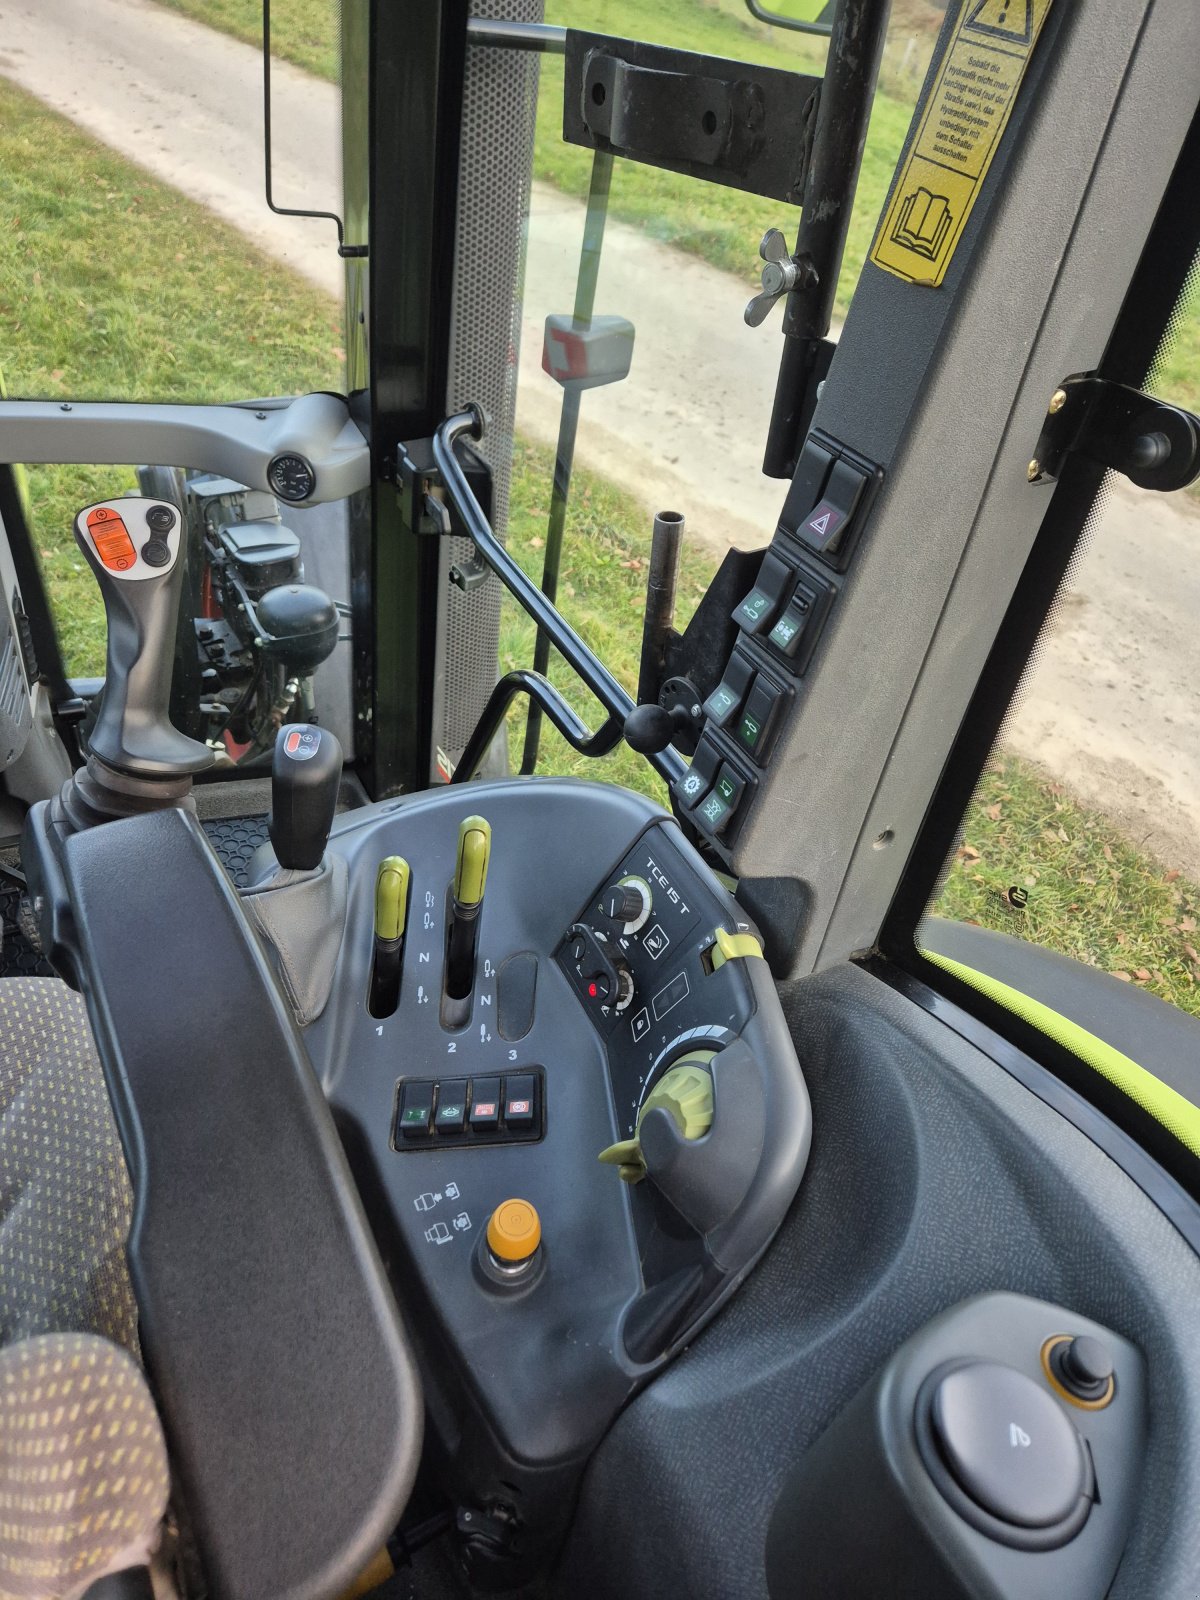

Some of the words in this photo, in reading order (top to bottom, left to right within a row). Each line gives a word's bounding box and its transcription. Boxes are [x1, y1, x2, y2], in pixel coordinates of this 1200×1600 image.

[967, 56, 990, 72] Sobald
[989, 64, 1001, 74] die
[939, 119, 969, 136] unbedingt
[936, 130, 949, 142] dem
[948, 134, 974, 151] Schalter
[932, 143, 968, 162] ausschalten
[646, 856, 670, 889] TCE
[679, 901, 690, 914] T
[419, 952, 430, 963] N
[480, 994, 491, 1006] N
[375, 1025, 384, 1036] 1
[447, 1042, 457, 1053] 2
[508, 1049, 518, 1061] 3
